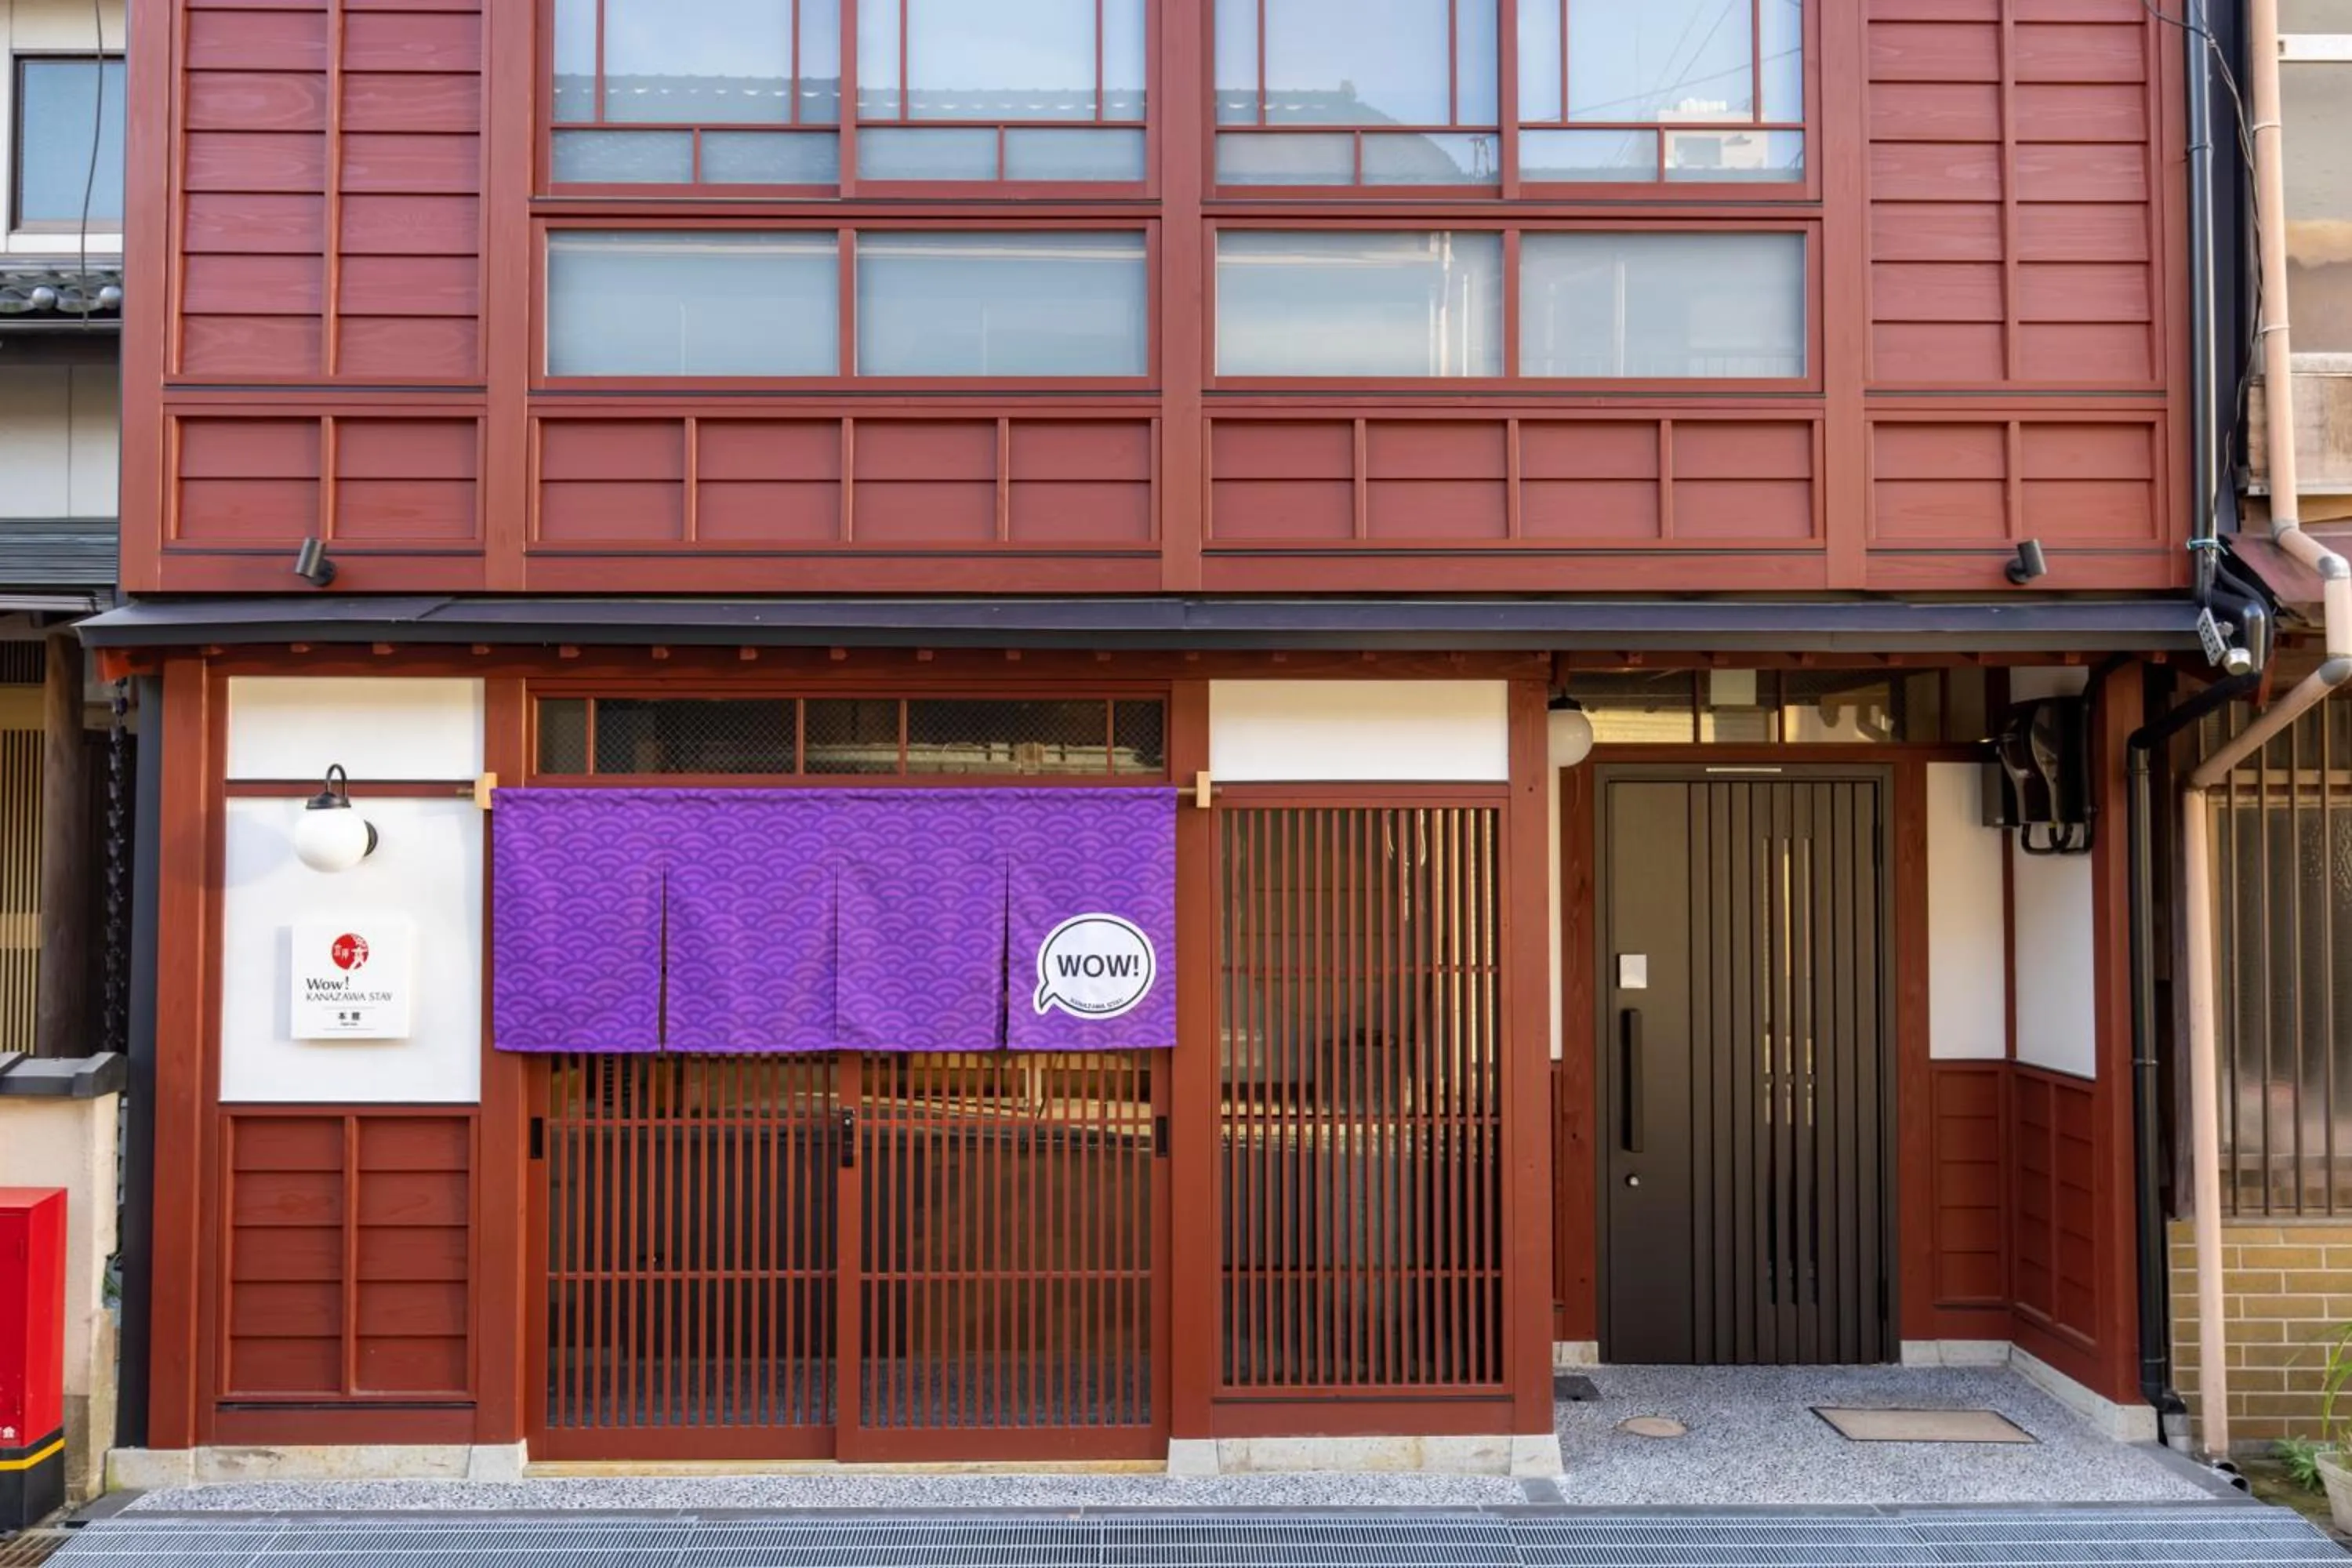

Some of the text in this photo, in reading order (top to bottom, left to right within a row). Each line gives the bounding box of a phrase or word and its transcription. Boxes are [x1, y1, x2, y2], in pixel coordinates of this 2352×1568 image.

[1056, 954, 1139, 978] WOW!
[306, 975, 350, 991] Wow!
[306, 992, 393, 1002] KANAZAWA STAY
